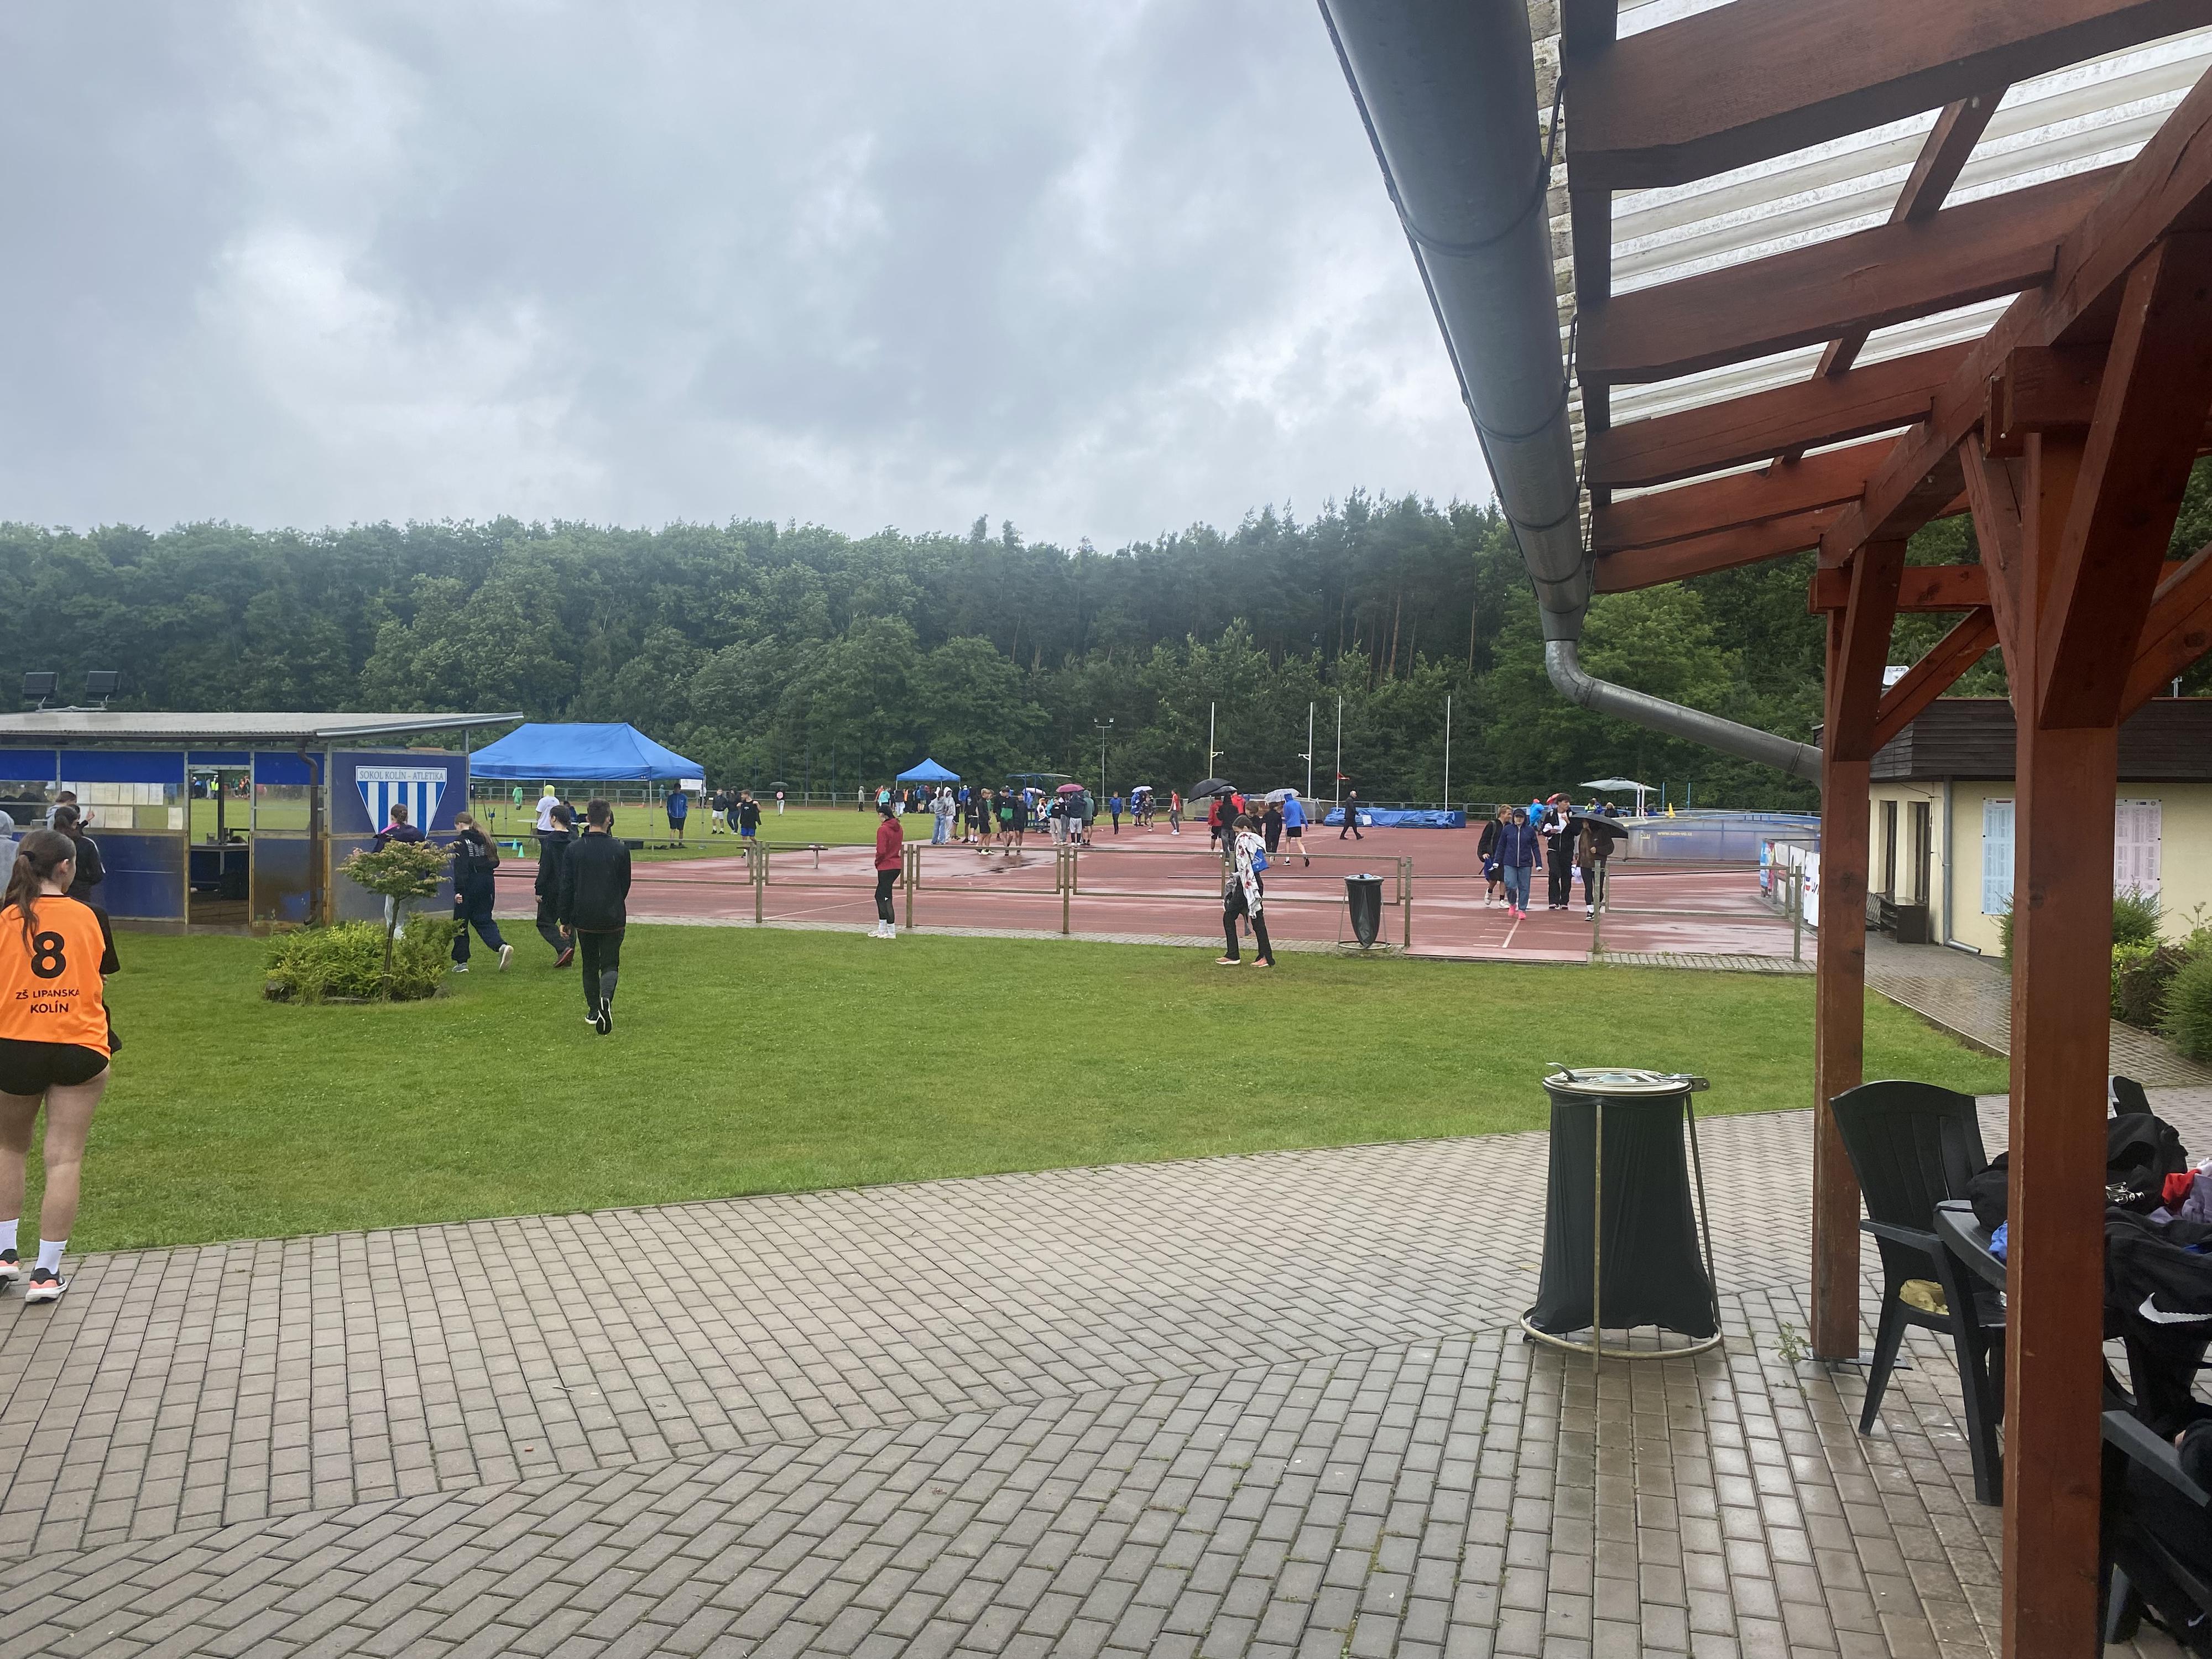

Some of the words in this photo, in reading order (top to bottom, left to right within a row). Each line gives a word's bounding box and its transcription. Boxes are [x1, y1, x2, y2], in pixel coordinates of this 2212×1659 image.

[359, 771, 383, 780] SOKOL
[385, 770, 406, 780] KOLÍN
[413, 772, 444, 780] ATLETIKA
[31, 931, 66, 978] 8
[15, 989, 29, 999] ZŠ
[30, 1000, 69, 1013] KOLÍN
